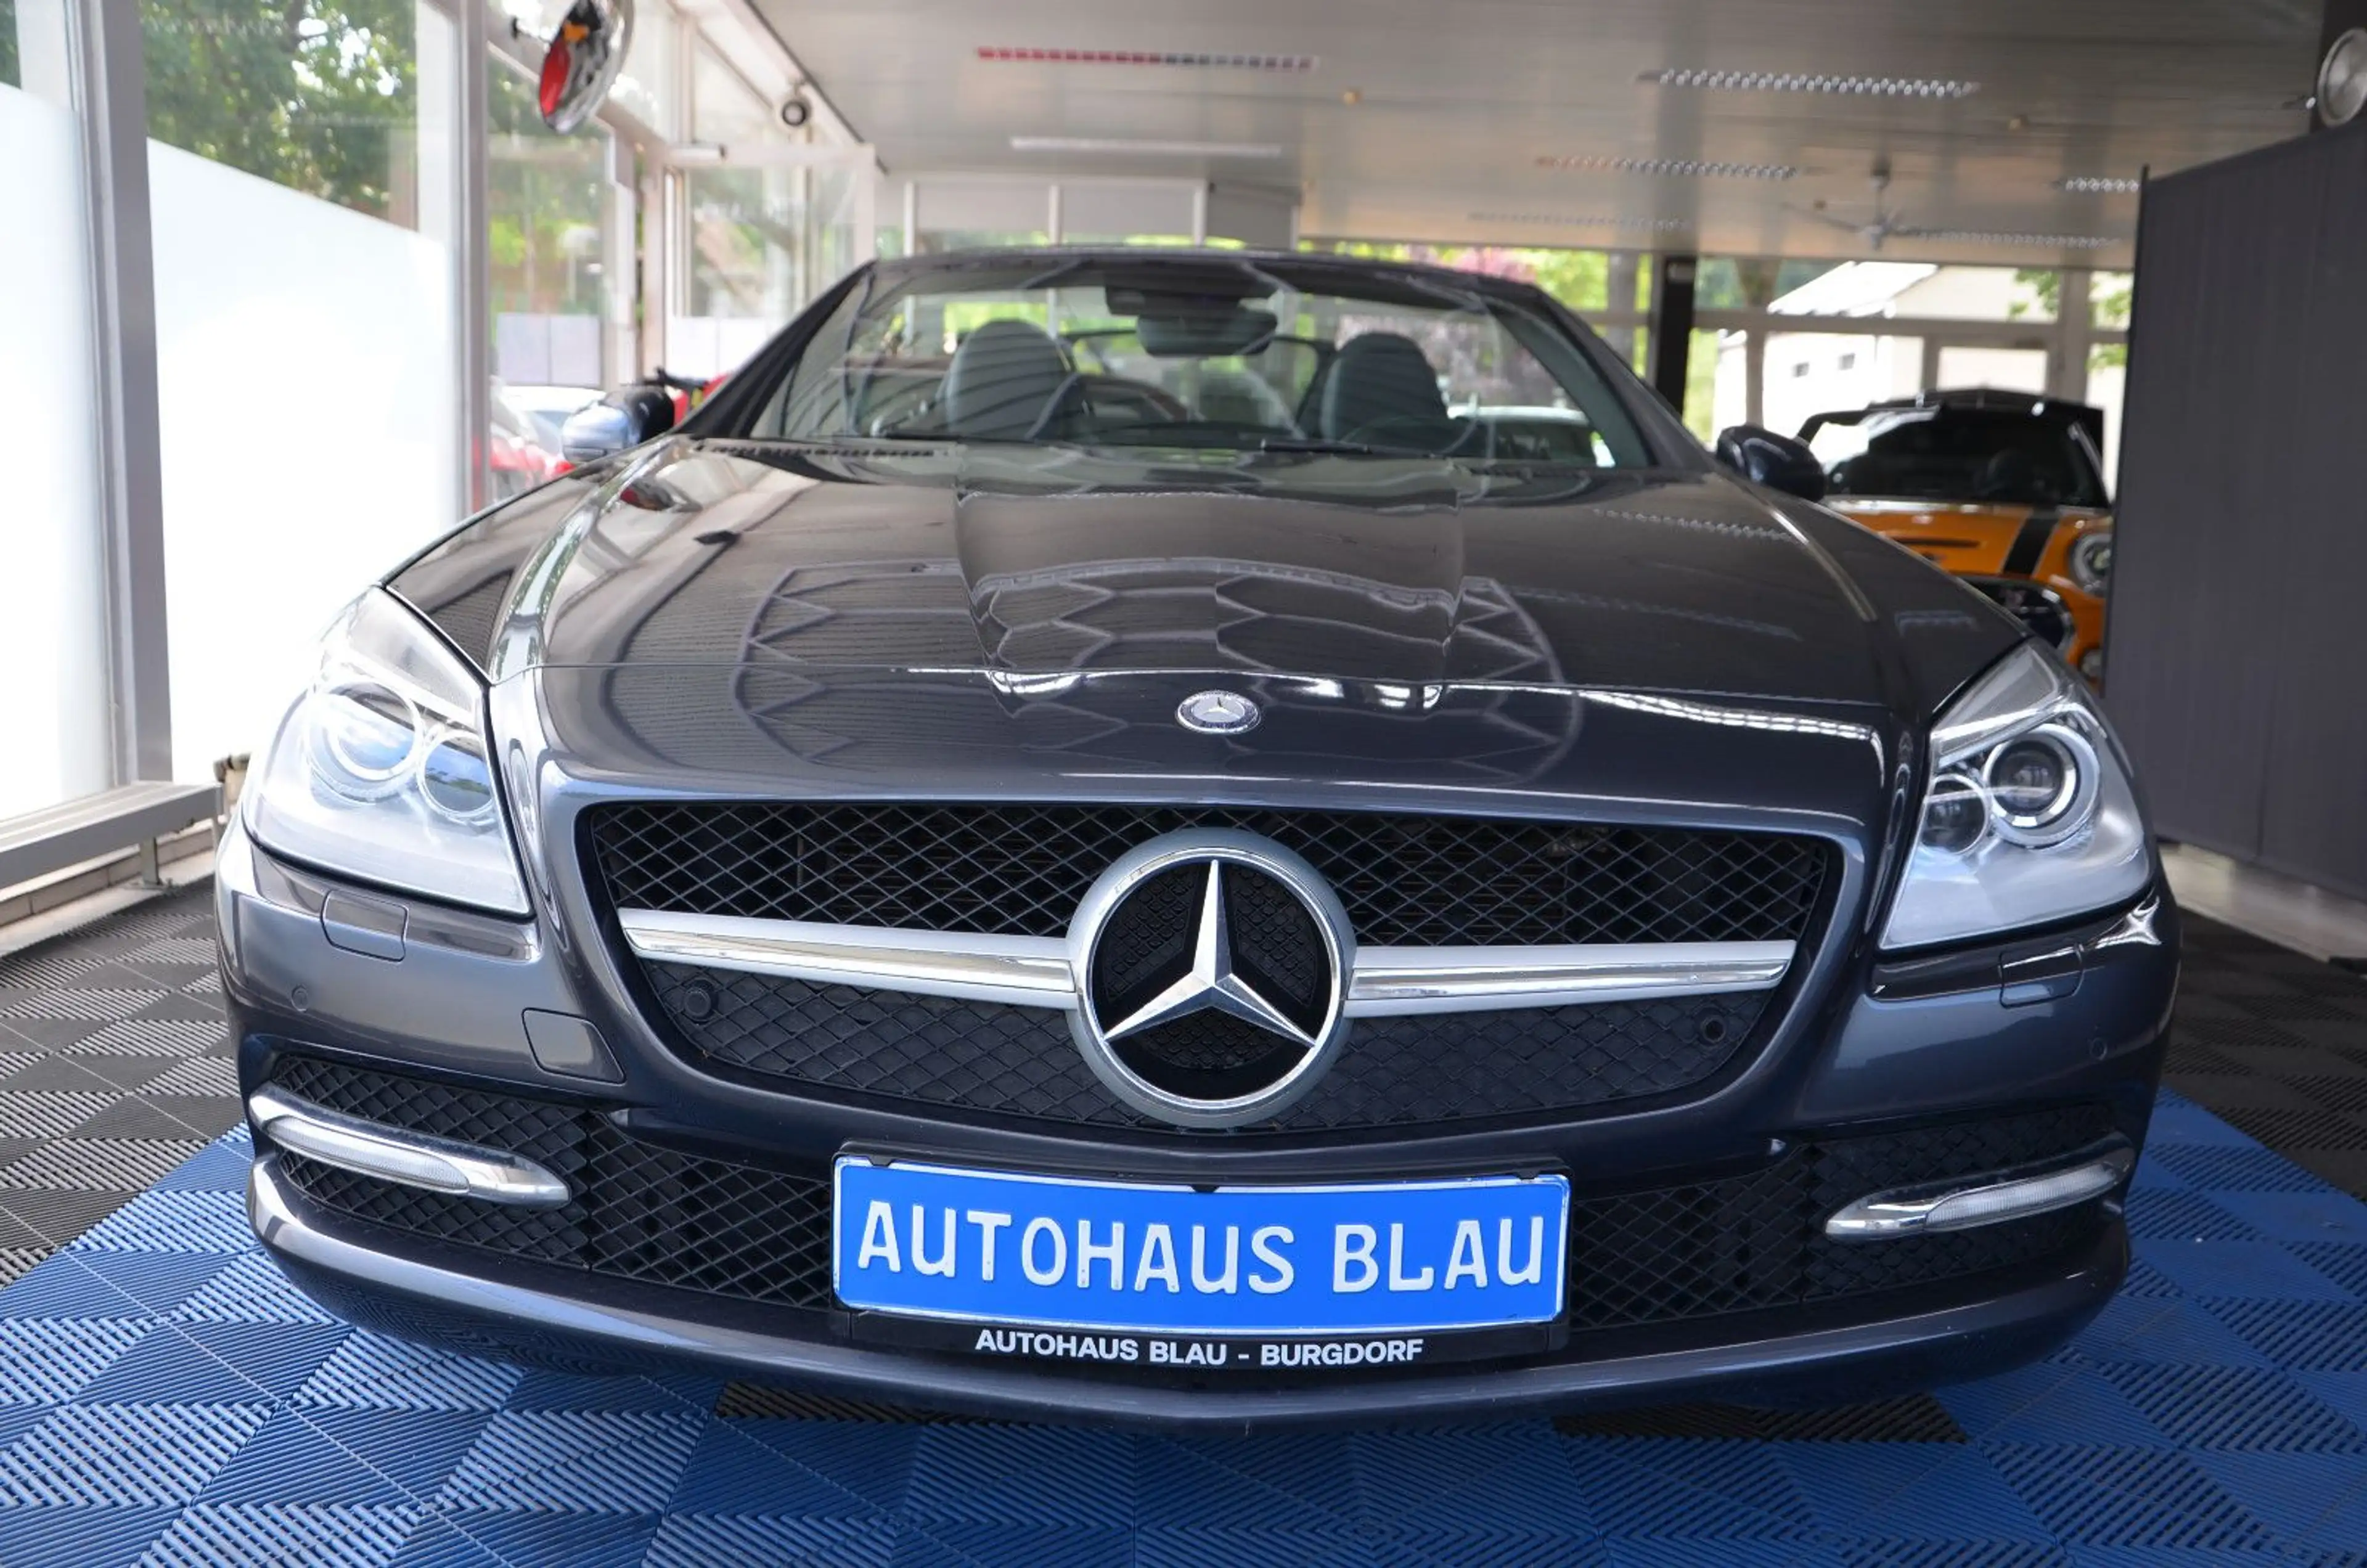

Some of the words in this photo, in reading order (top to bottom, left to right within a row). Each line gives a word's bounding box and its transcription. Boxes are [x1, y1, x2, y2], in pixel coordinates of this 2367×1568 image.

[857, 1199, 1294, 1294] AUTOHAUS
[1333, 1216, 1543, 1292] BLAU
[974, 1329, 1139, 1361] AUTOHAUS
[1149, 1341, 1227, 1365] BLAU
[1261, 1339, 1425, 1366] BURGDORF
